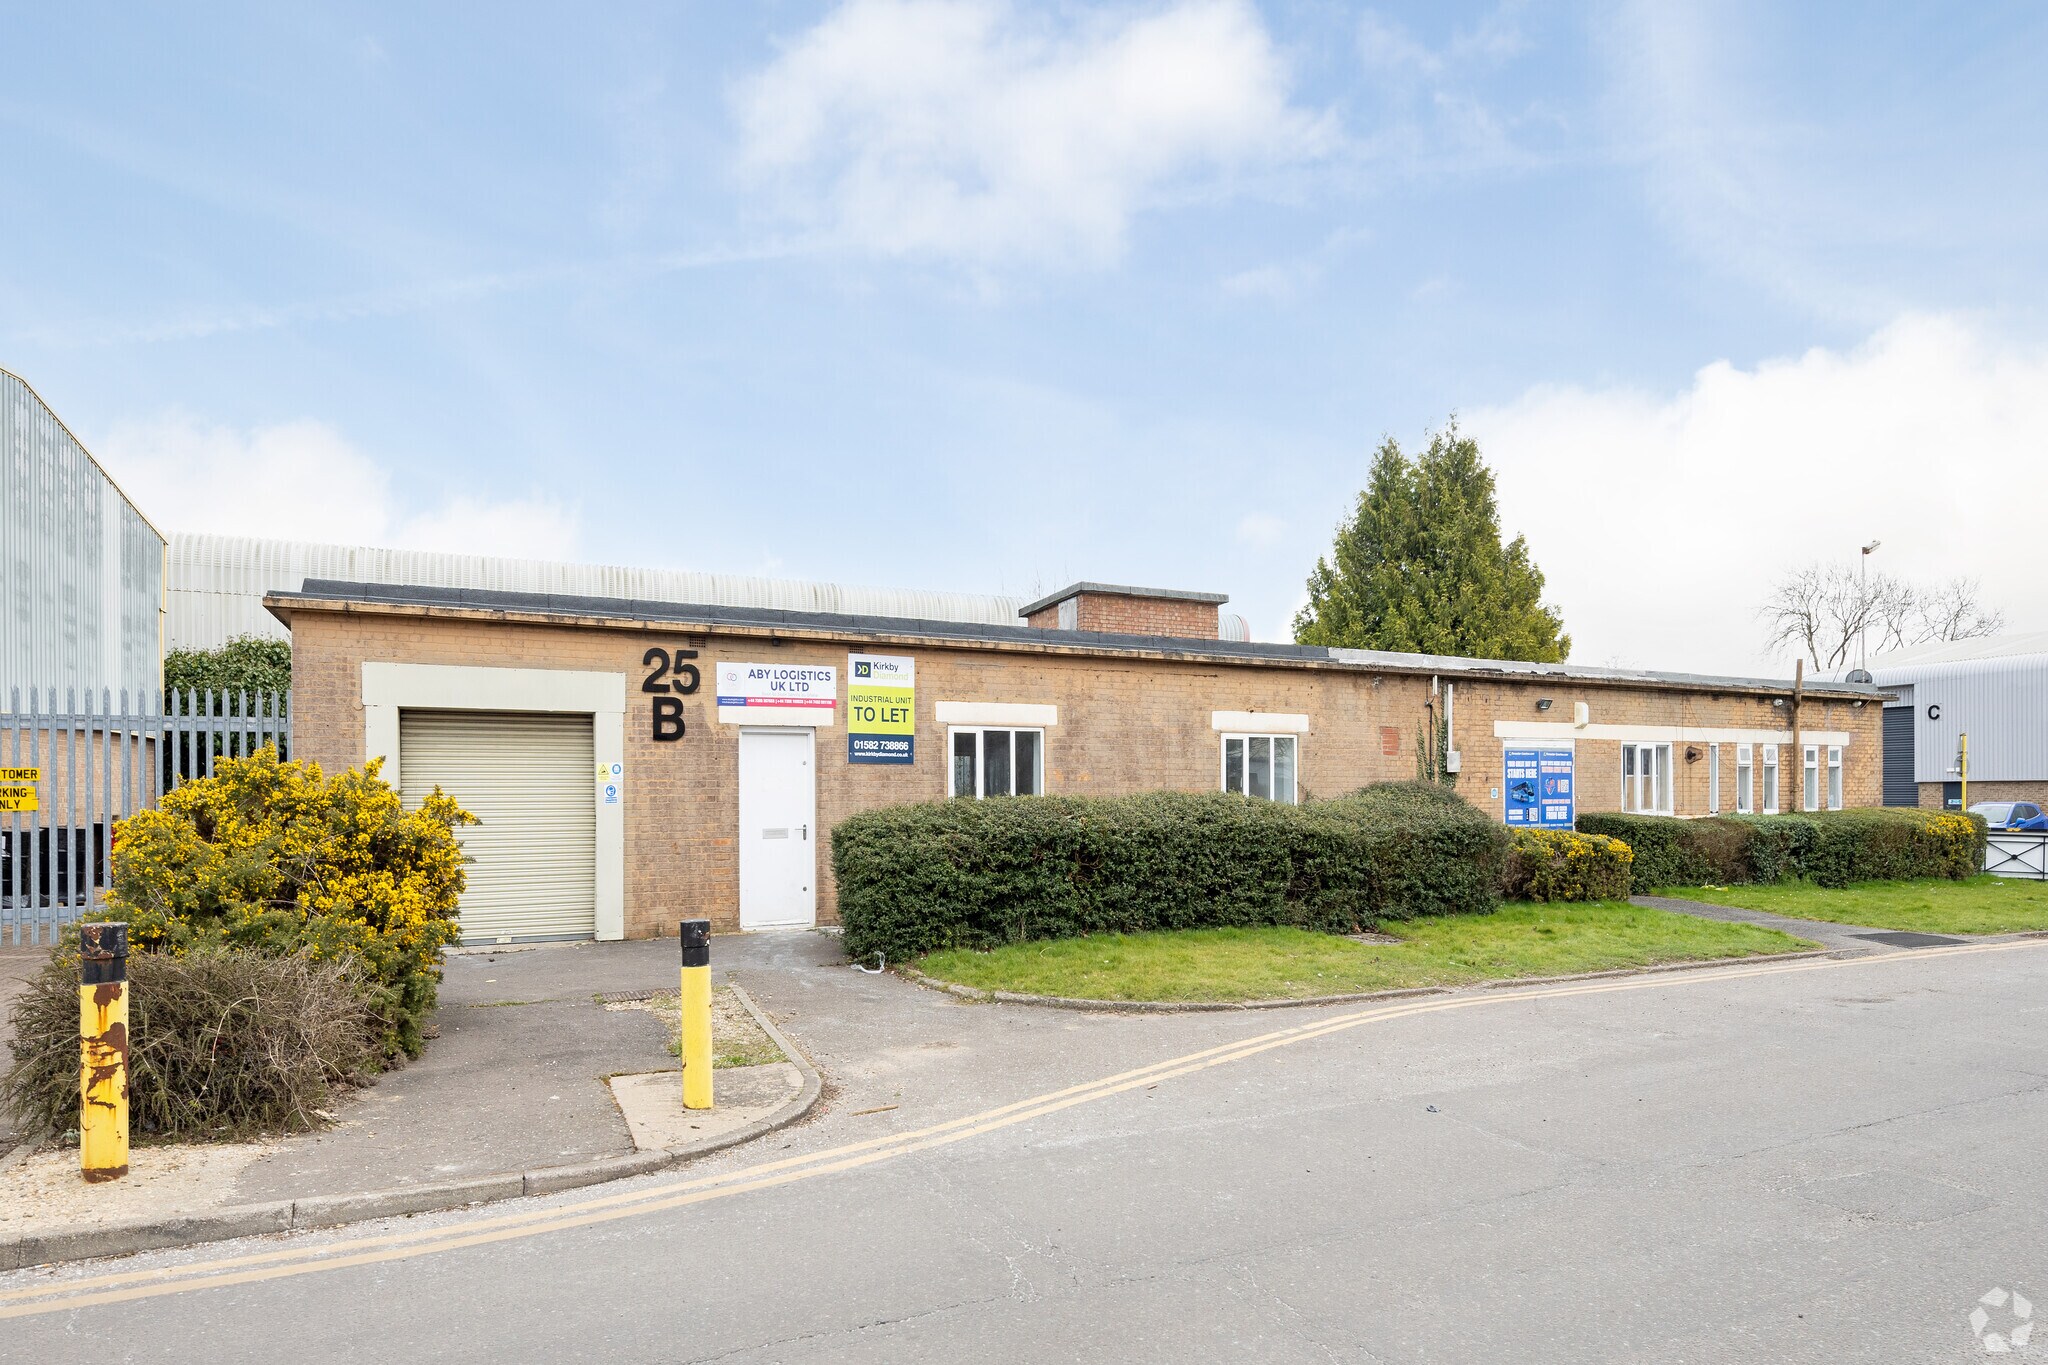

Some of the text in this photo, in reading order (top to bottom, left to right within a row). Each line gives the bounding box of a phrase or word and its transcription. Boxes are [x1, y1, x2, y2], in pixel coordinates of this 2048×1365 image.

[642, 647, 700, 695] 25
[873, 661, 899, 673] Kirkby
[748, 669, 831, 681] ABY LOGISTICS
[873, 670, 909, 681] Diamond
[770, 681, 810, 692] UK LTD
[850, 694, 894, 704] INDUSTRIAL
[853, 706, 909, 723] TO LET
[1927, 704, 1941, 720] C
[653, 696, 685, 741] B
[853, 740, 909, 751] 01582 738866
[0, 788, 27, 797] KING
